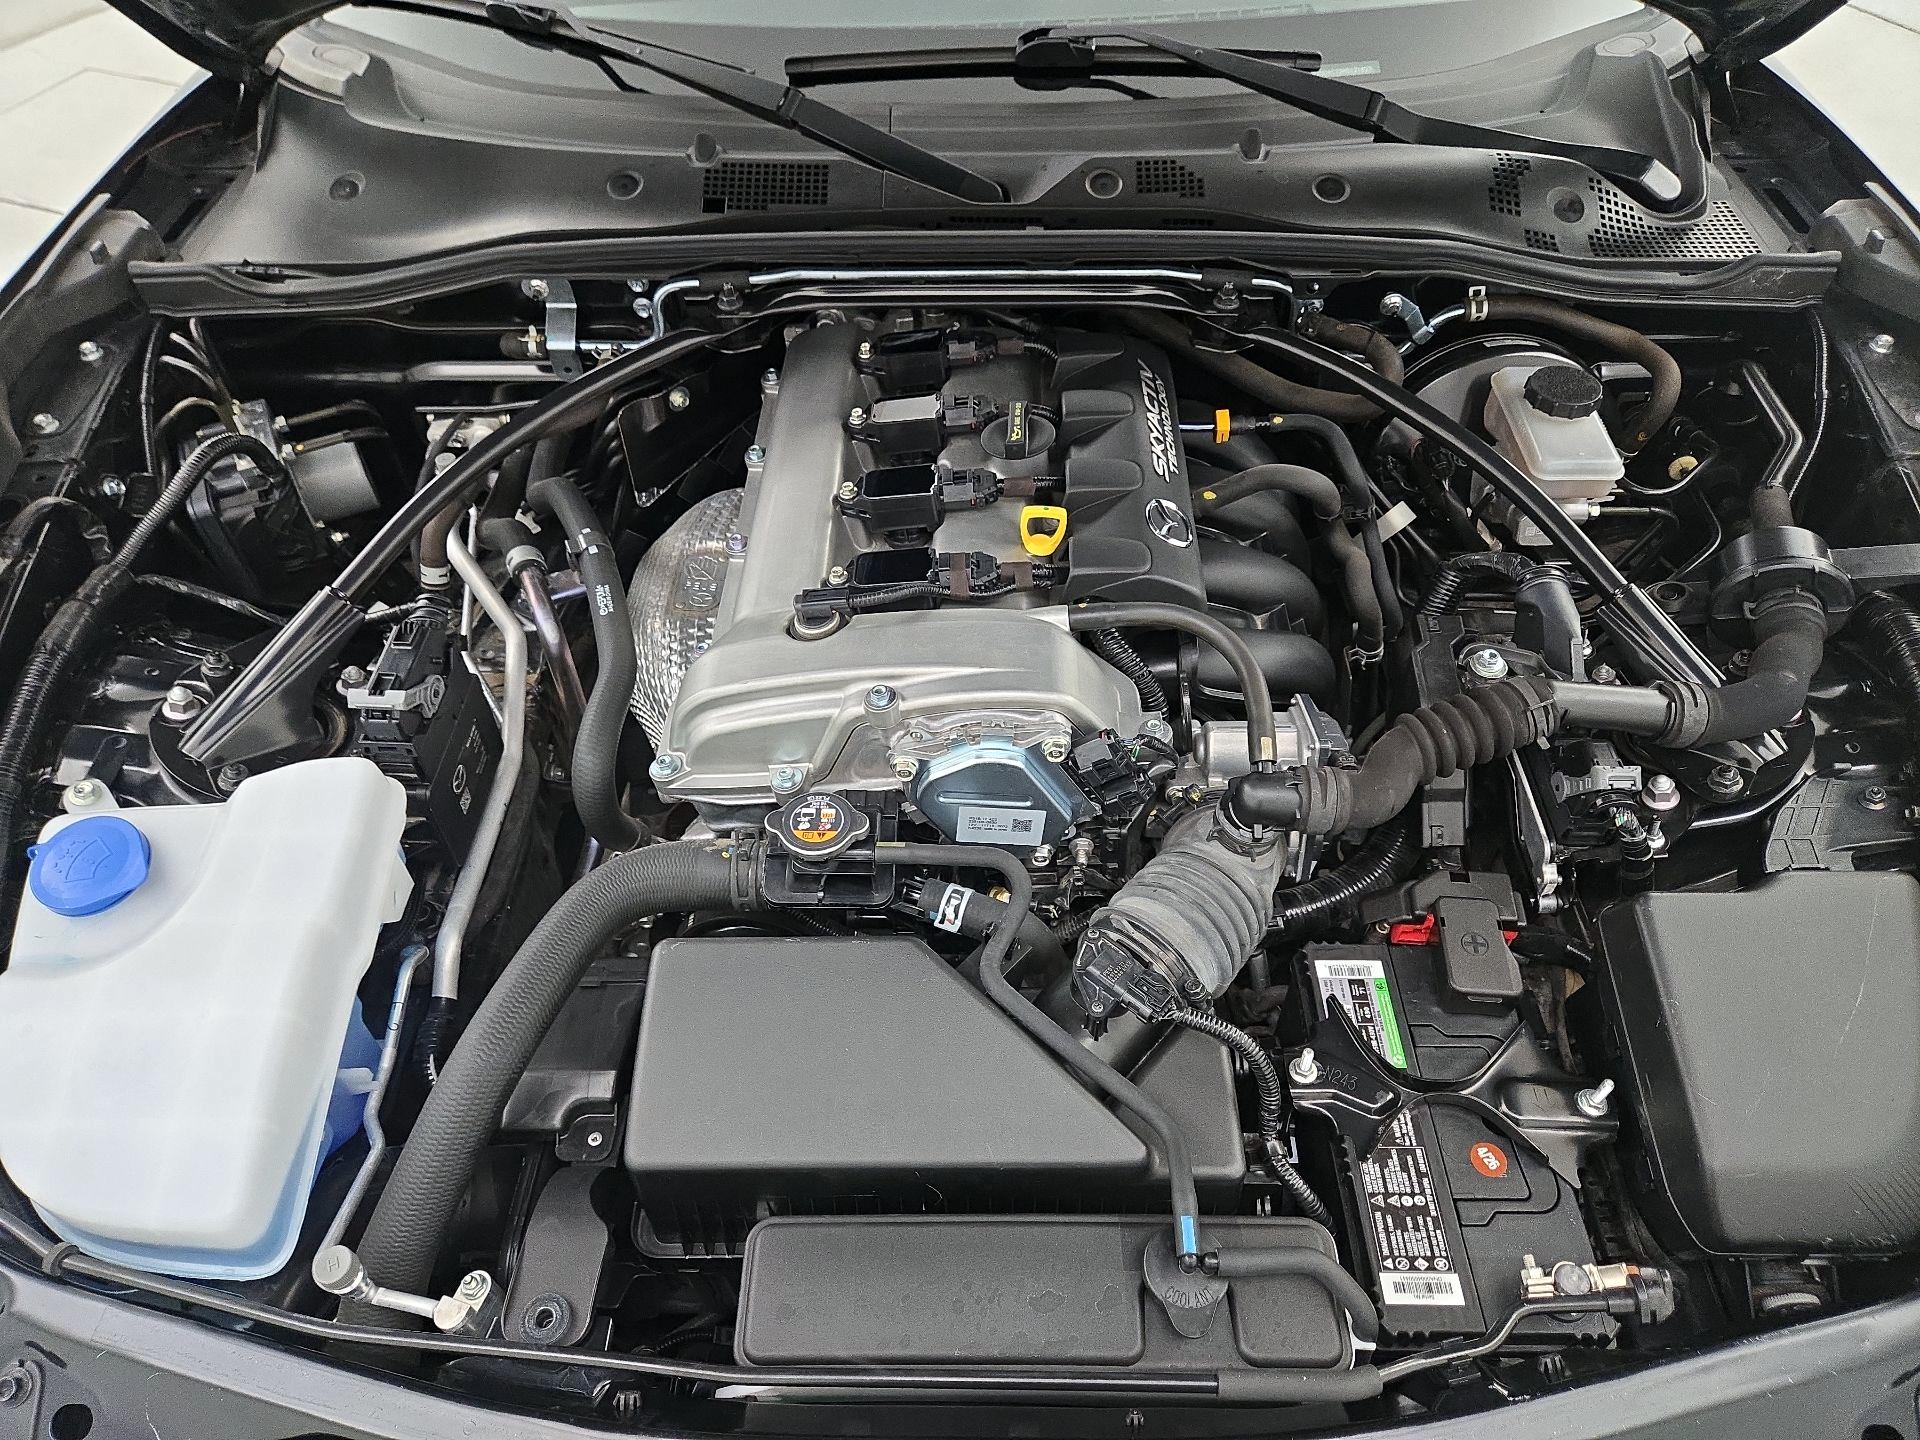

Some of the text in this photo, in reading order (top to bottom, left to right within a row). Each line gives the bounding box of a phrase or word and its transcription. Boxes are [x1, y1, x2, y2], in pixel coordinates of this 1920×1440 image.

[1138, 358, 1170, 483] SKYACTIV
[1155, 373, 1179, 475] TECHNOLOGY
[1477, 1147, 1500, 1170] 4/26
[1161, 1284, 1216, 1308] COOLANT
